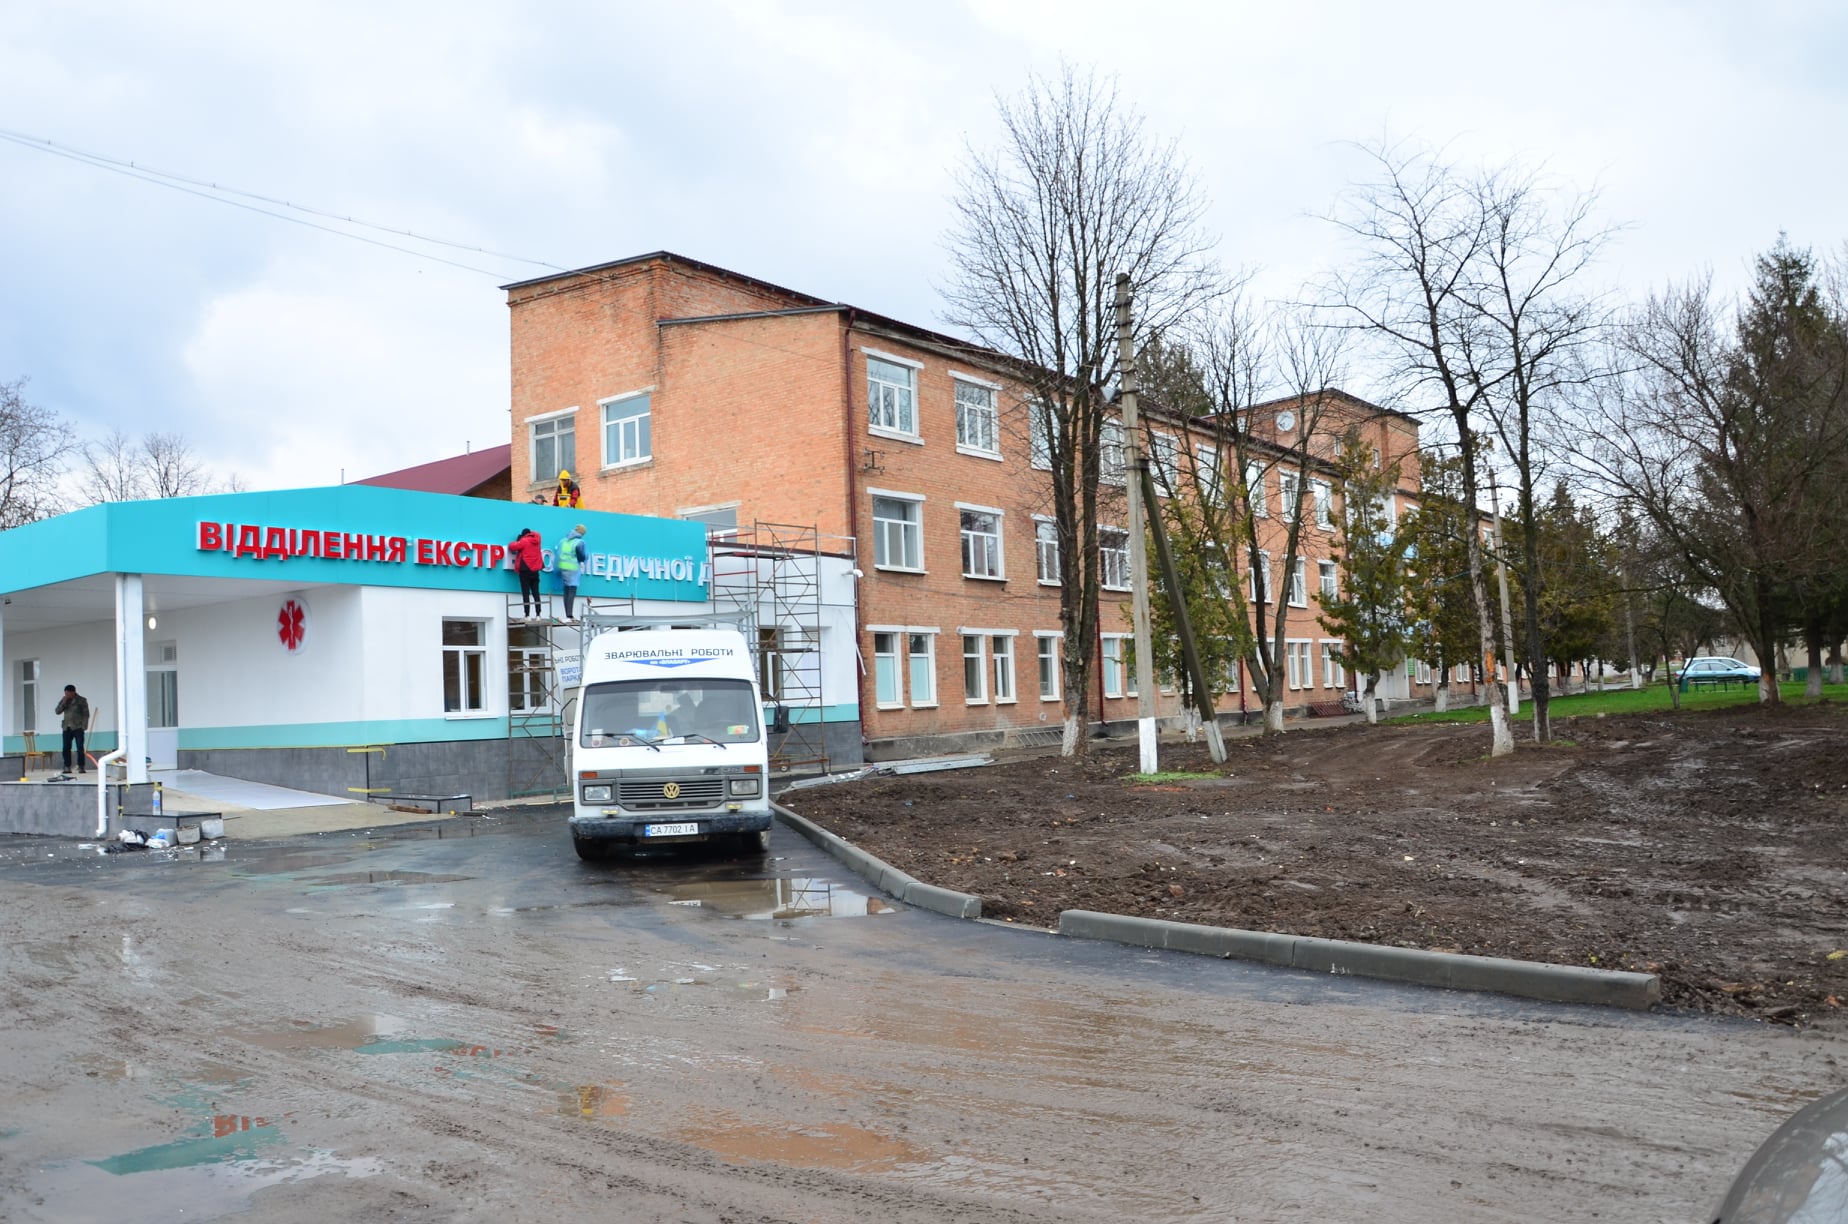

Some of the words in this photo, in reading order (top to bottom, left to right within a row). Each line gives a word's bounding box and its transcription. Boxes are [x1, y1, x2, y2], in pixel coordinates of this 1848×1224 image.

[197, 521, 406, 563] ВІДДІЛЕННЯ
[604, 649, 683, 660] ЗВАРЮВАЛЬНІ
[691, 648, 734, 657] РОБОТИ
